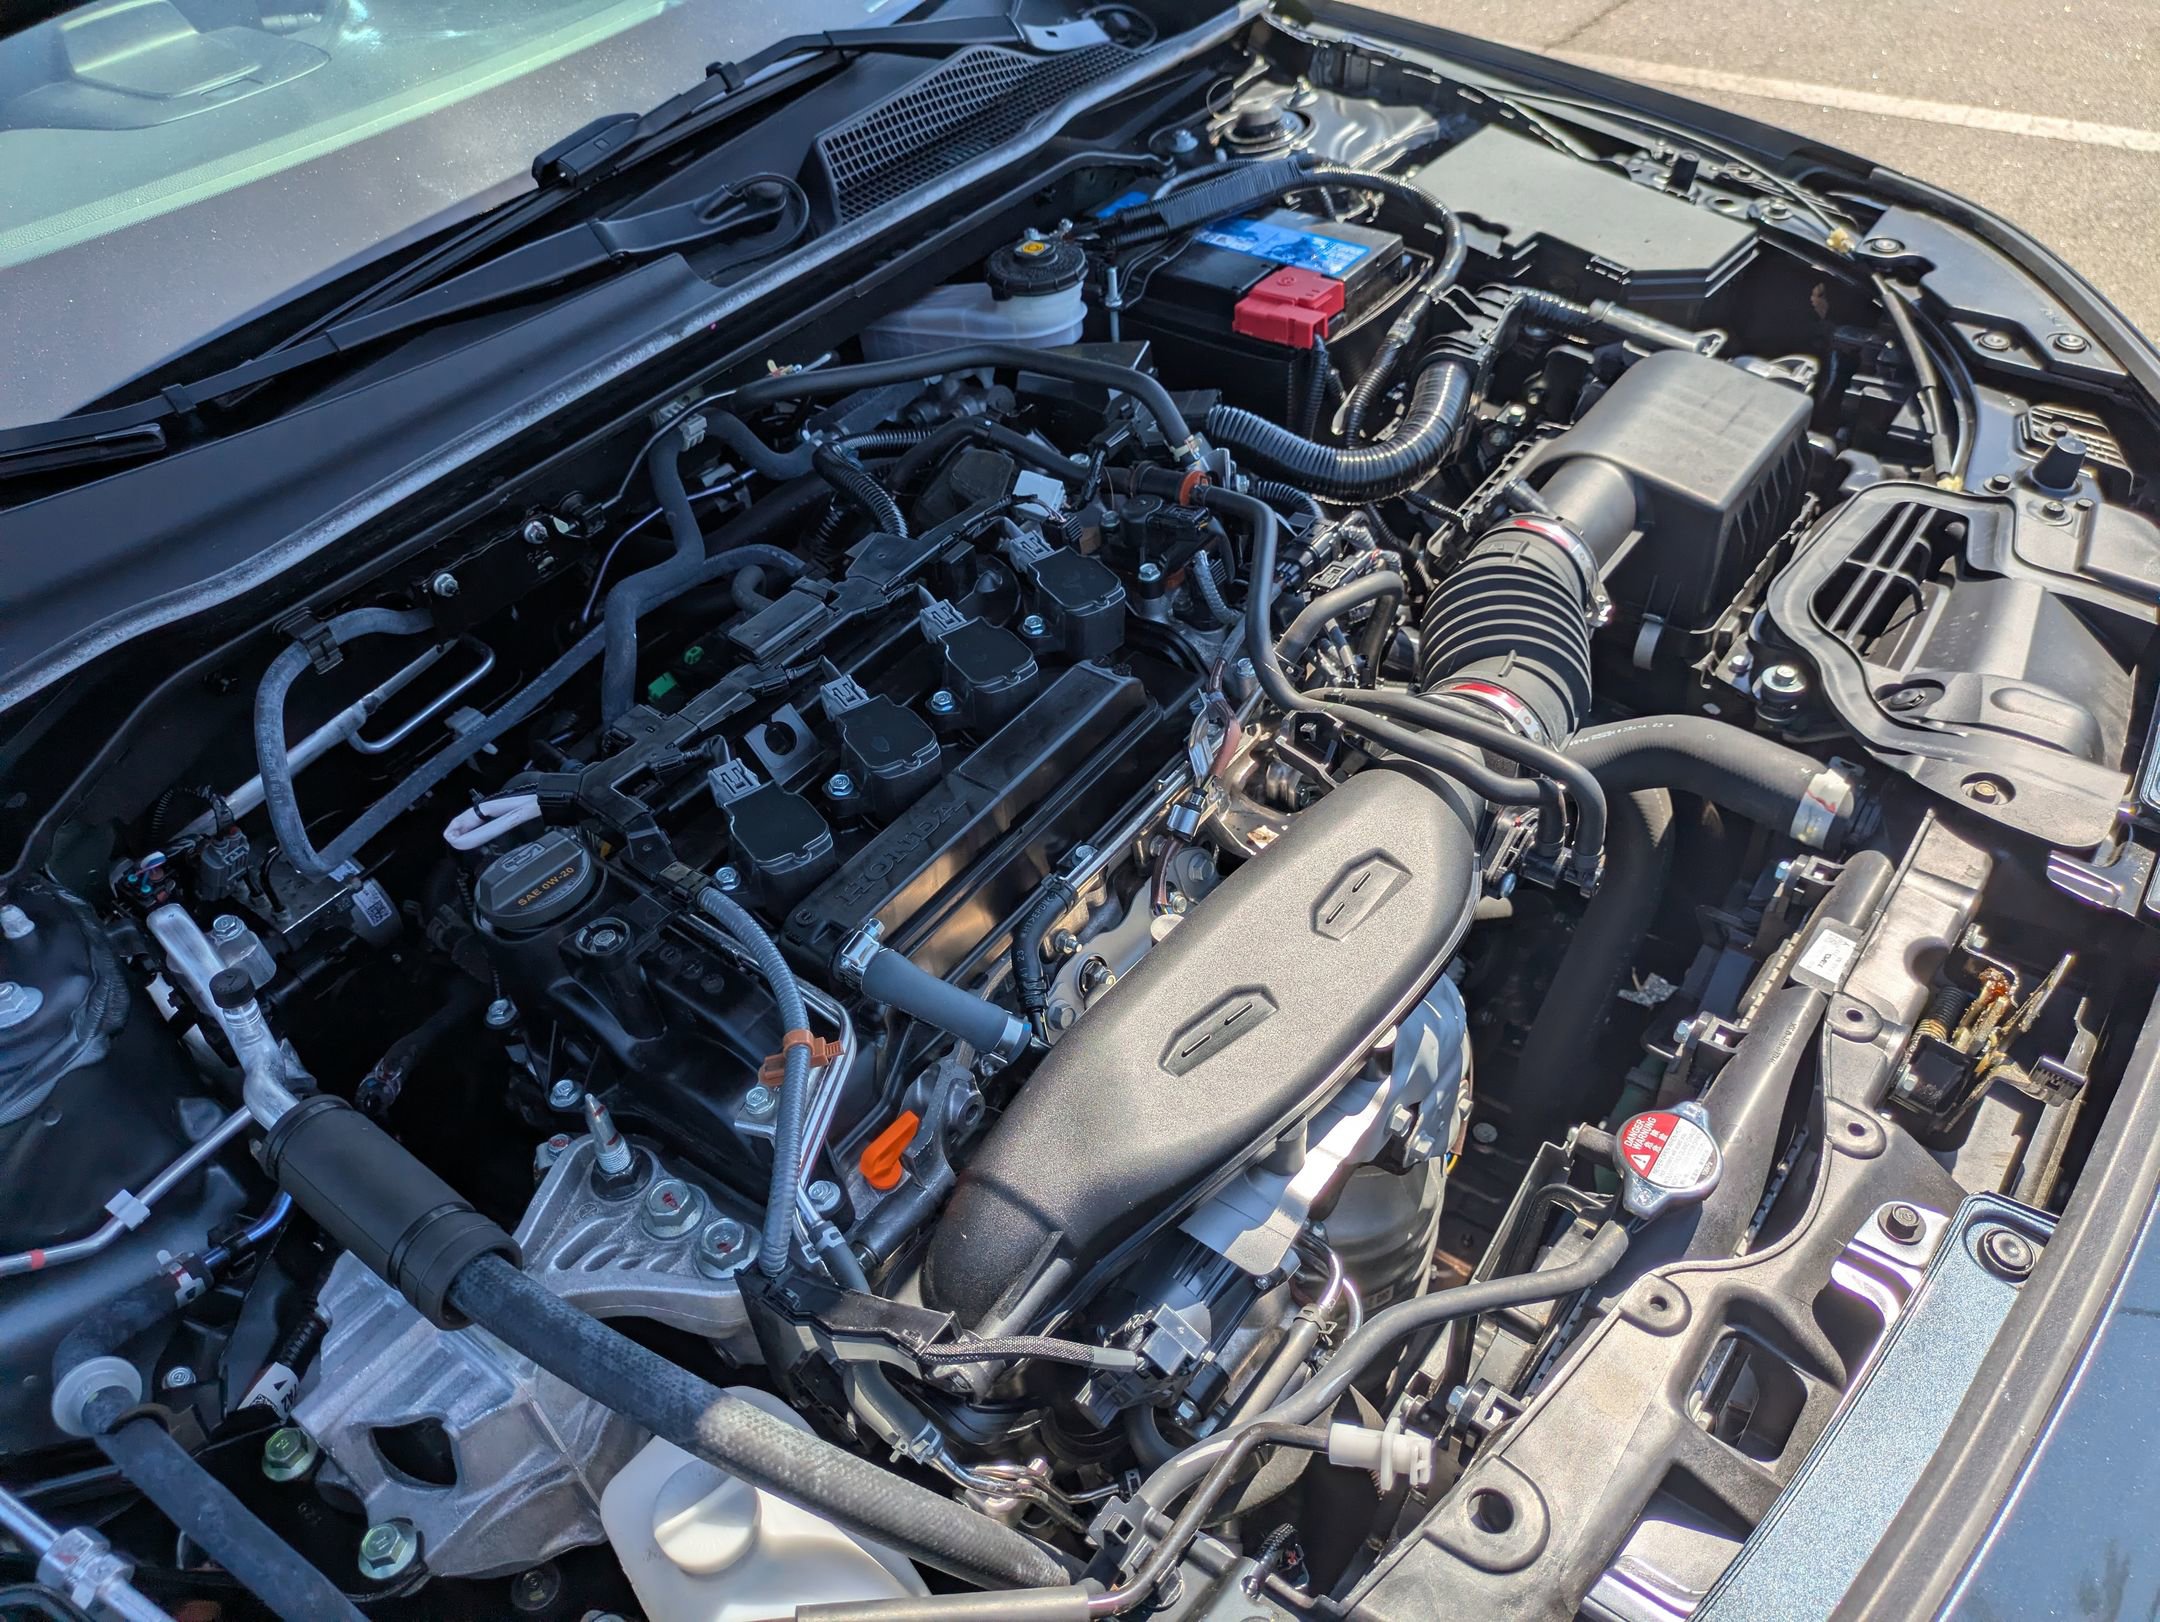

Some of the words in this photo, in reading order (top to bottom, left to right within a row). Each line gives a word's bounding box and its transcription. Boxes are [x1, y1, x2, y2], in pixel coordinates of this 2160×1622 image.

[834, 800, 967, 905] HONDA
[518, 888, 542, 906] SAE
[542, 867, 575, 890] 0W-20
[1624, 1119, 1645, 1147] DANGER
[1632, 1117, 1657, 1150] WARNUNG
